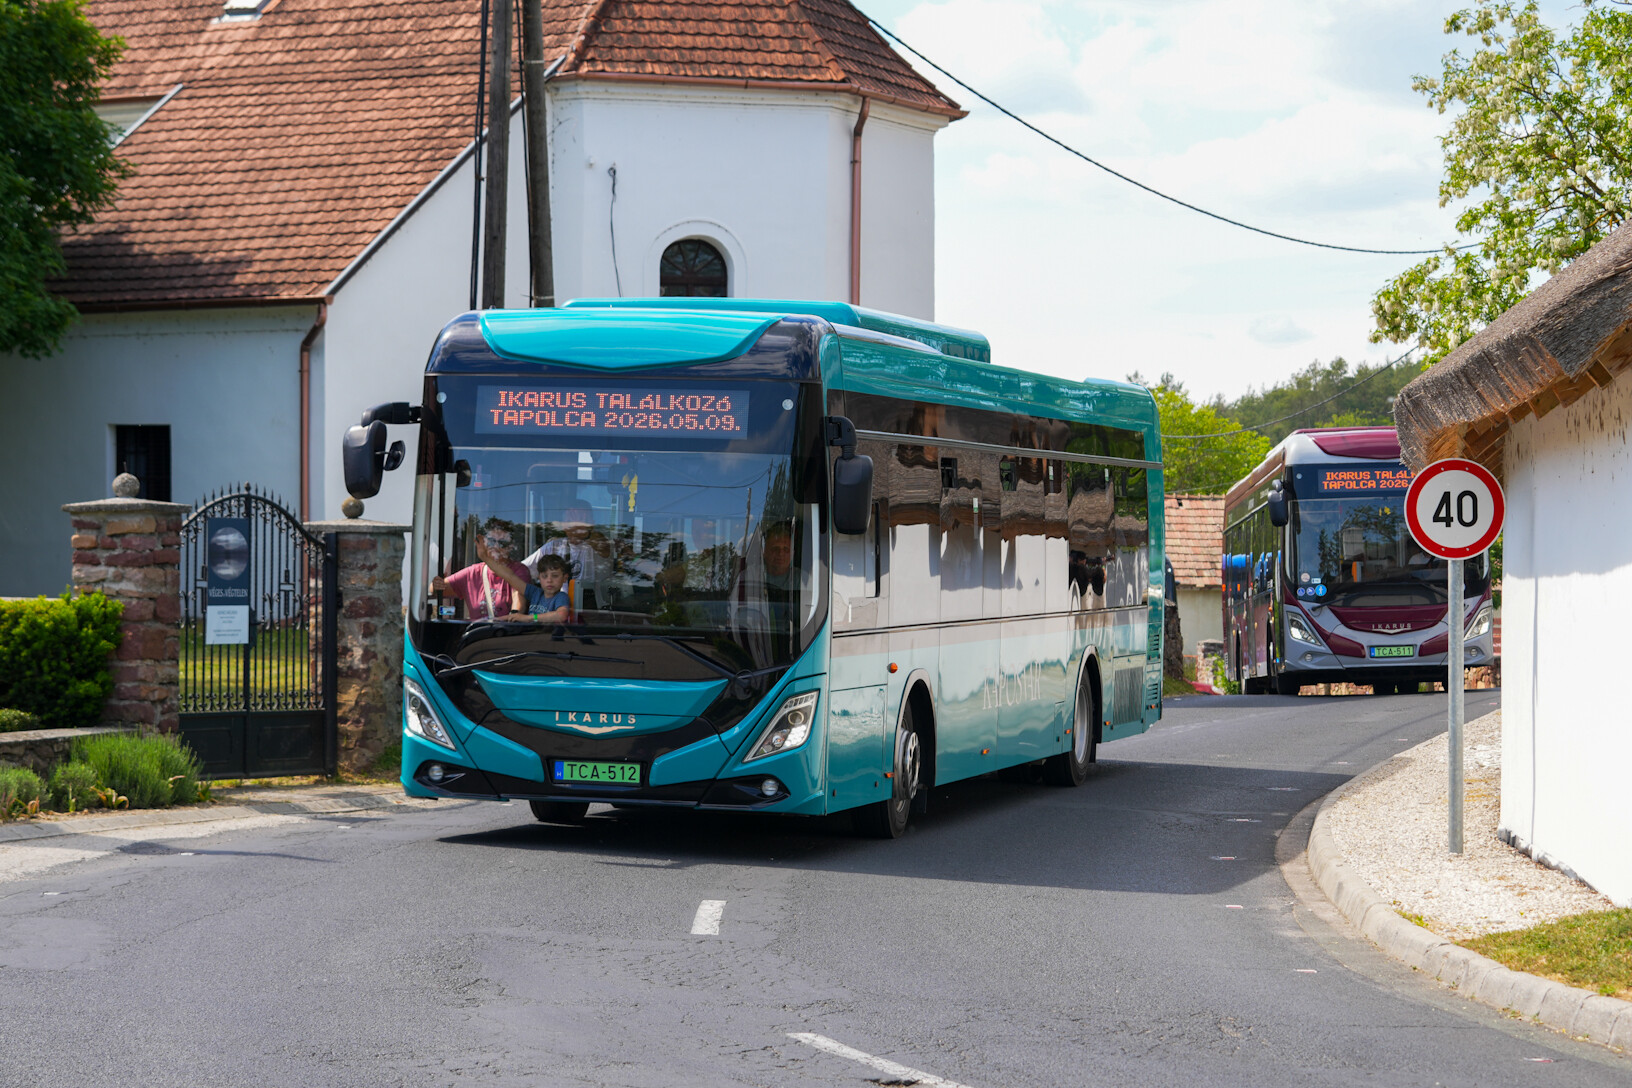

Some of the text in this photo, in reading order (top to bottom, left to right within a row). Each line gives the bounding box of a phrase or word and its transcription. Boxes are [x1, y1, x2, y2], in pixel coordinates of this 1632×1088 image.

[498, 391, 587, 408] IKARUS
[490, 409, 741, 431] TAPOLCA 2026.05.09.
[1325, 471, 1371, 481] IKARUS
[1322, 480, 1377, 490] TAPOLCA
[1432, 490, 1478, 528] 40
[1377, 647, 1411, 656] TCA-511
[555, 711, 636, 724] IKARUS
[567, 763, 637, 781] TCA-512
